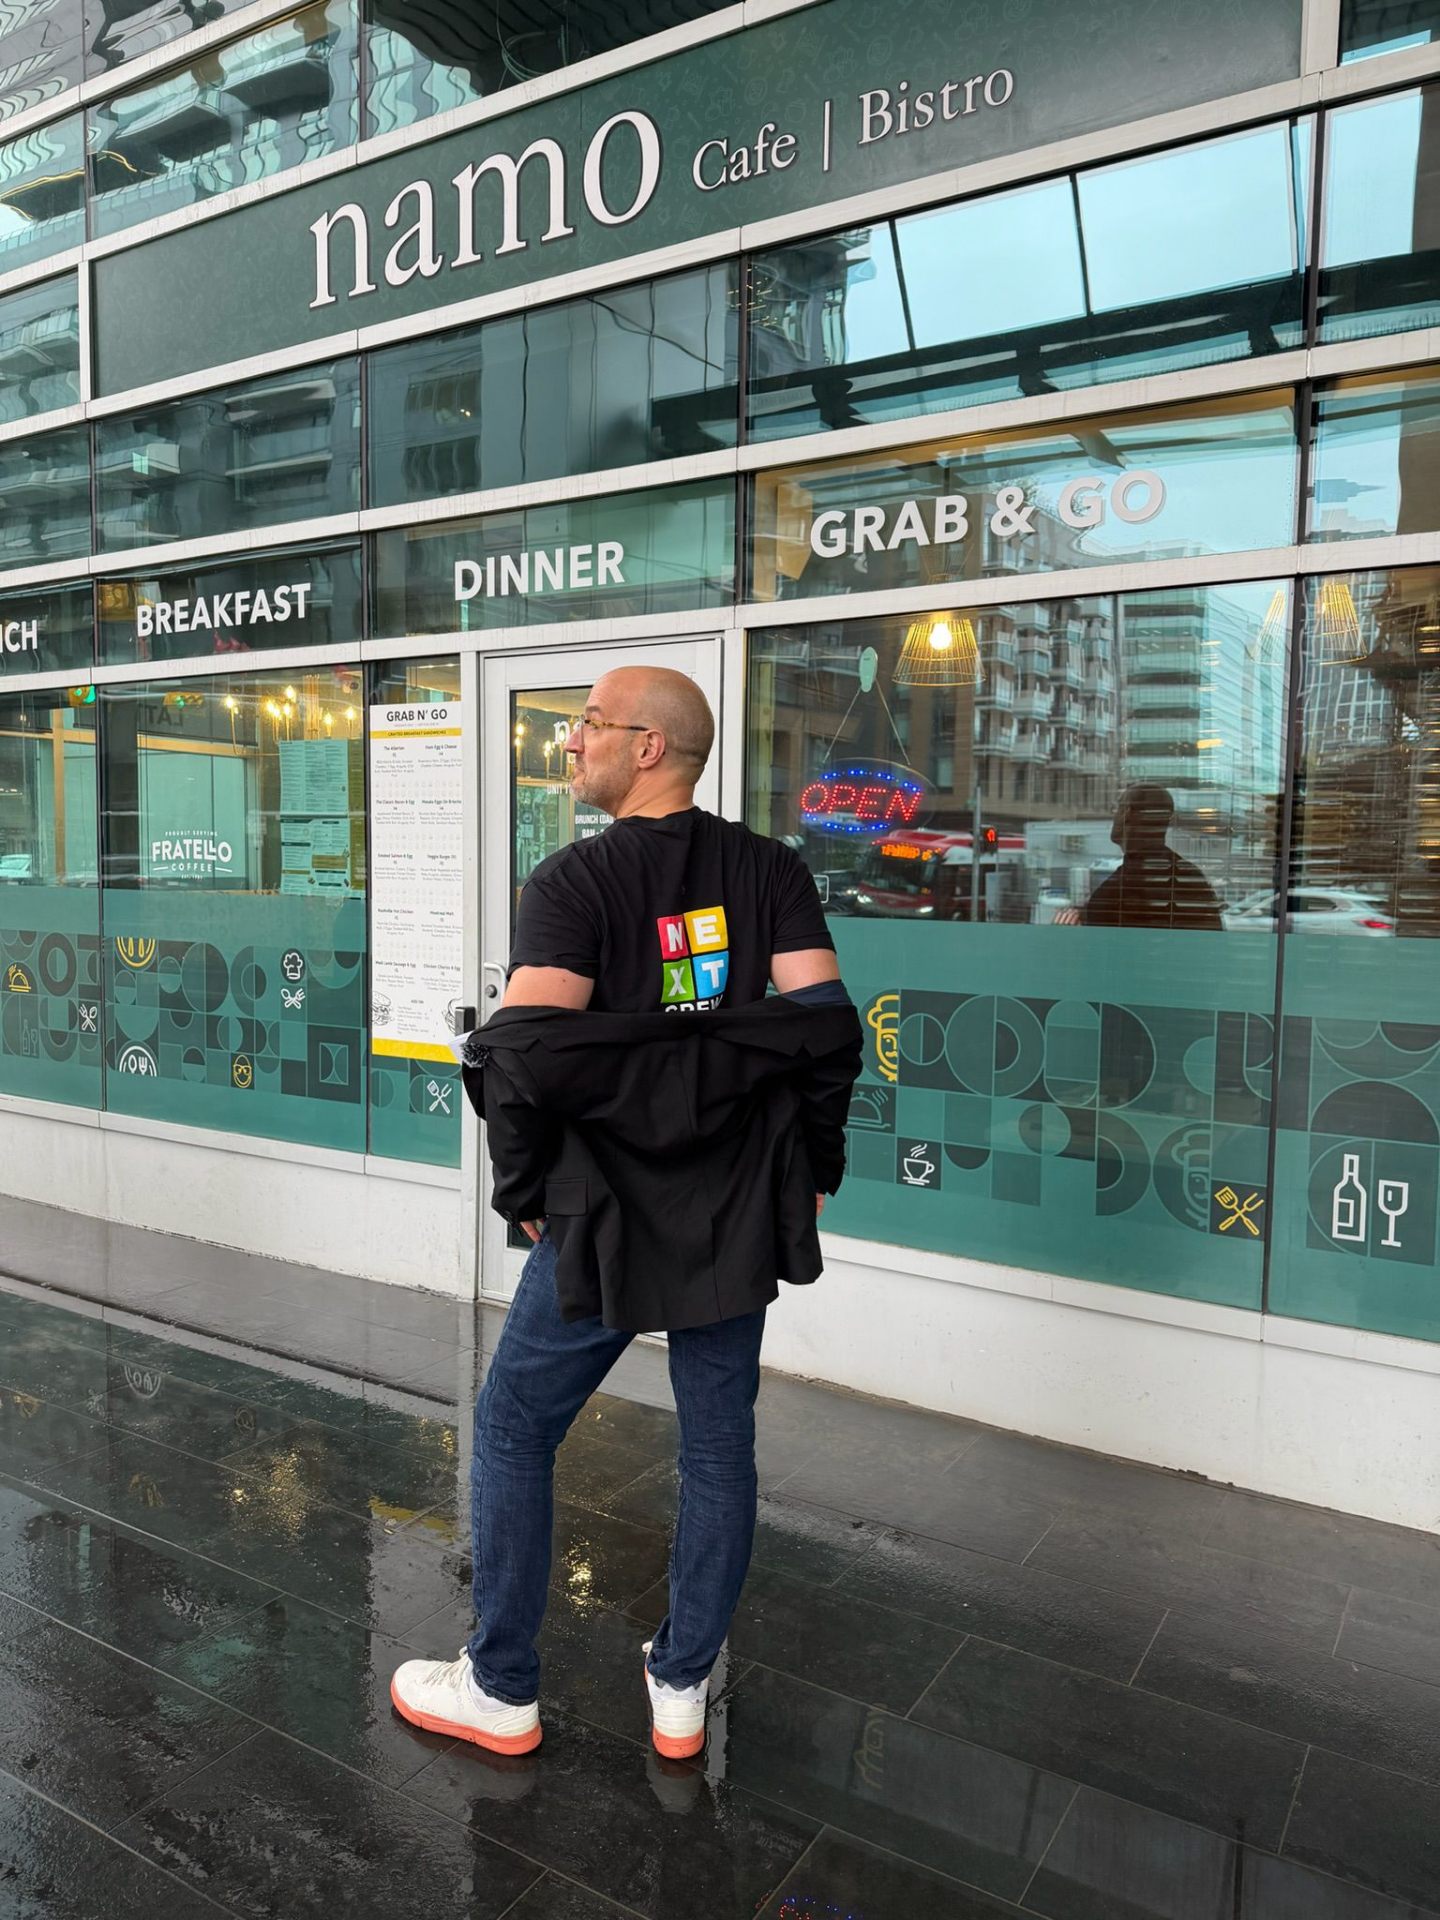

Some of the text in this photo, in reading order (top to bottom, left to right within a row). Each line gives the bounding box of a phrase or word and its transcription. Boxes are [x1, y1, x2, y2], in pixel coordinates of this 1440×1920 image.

[309, 110, 660, 309] namo
[692, 122, 796, 191] Cafe
[858, 68, 1014, 145] Bistro
[810, 469, 1167, 559] GRAB & GO
[454, 540, 625, 601] DINNER
[136, 582, 312, 638] BREAKFAST
[386, 710, 415, 722] GRAB
[431, 708, 448, 720] GO
[547, 783, 563, 795] UNIT
[800, 783, 922, 822] OPEN
[151, 838, 233, 863] FRATELLO
[171, 862, 213, 873] COFFEE
